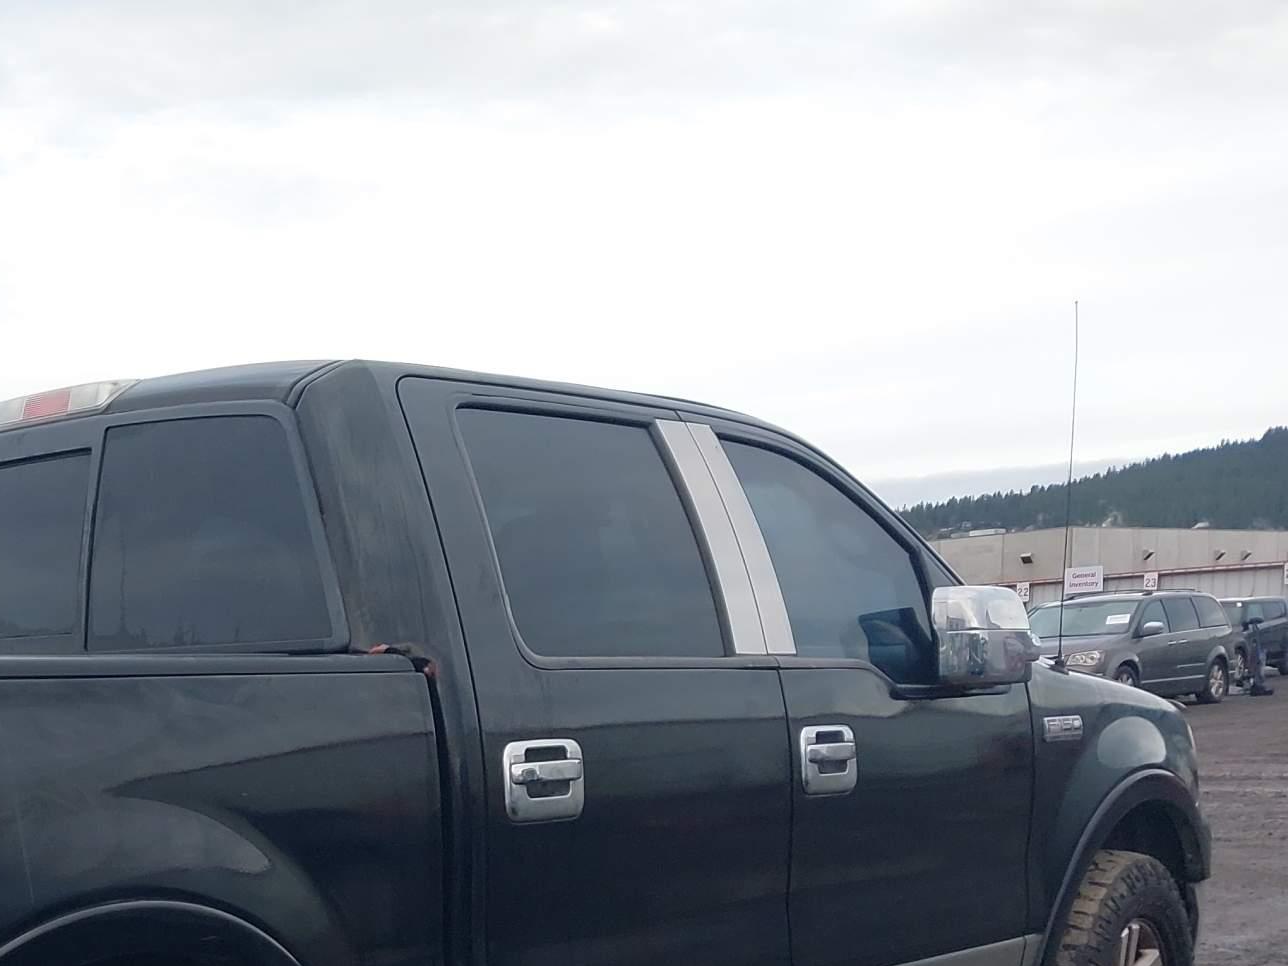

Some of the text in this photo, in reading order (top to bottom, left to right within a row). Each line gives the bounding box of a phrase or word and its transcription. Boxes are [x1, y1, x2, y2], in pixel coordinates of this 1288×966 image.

[1072, 571, 1097, 579] General
[1145, 577, 1156, 588] 23
[1017, 587, 1029, 597] 22
